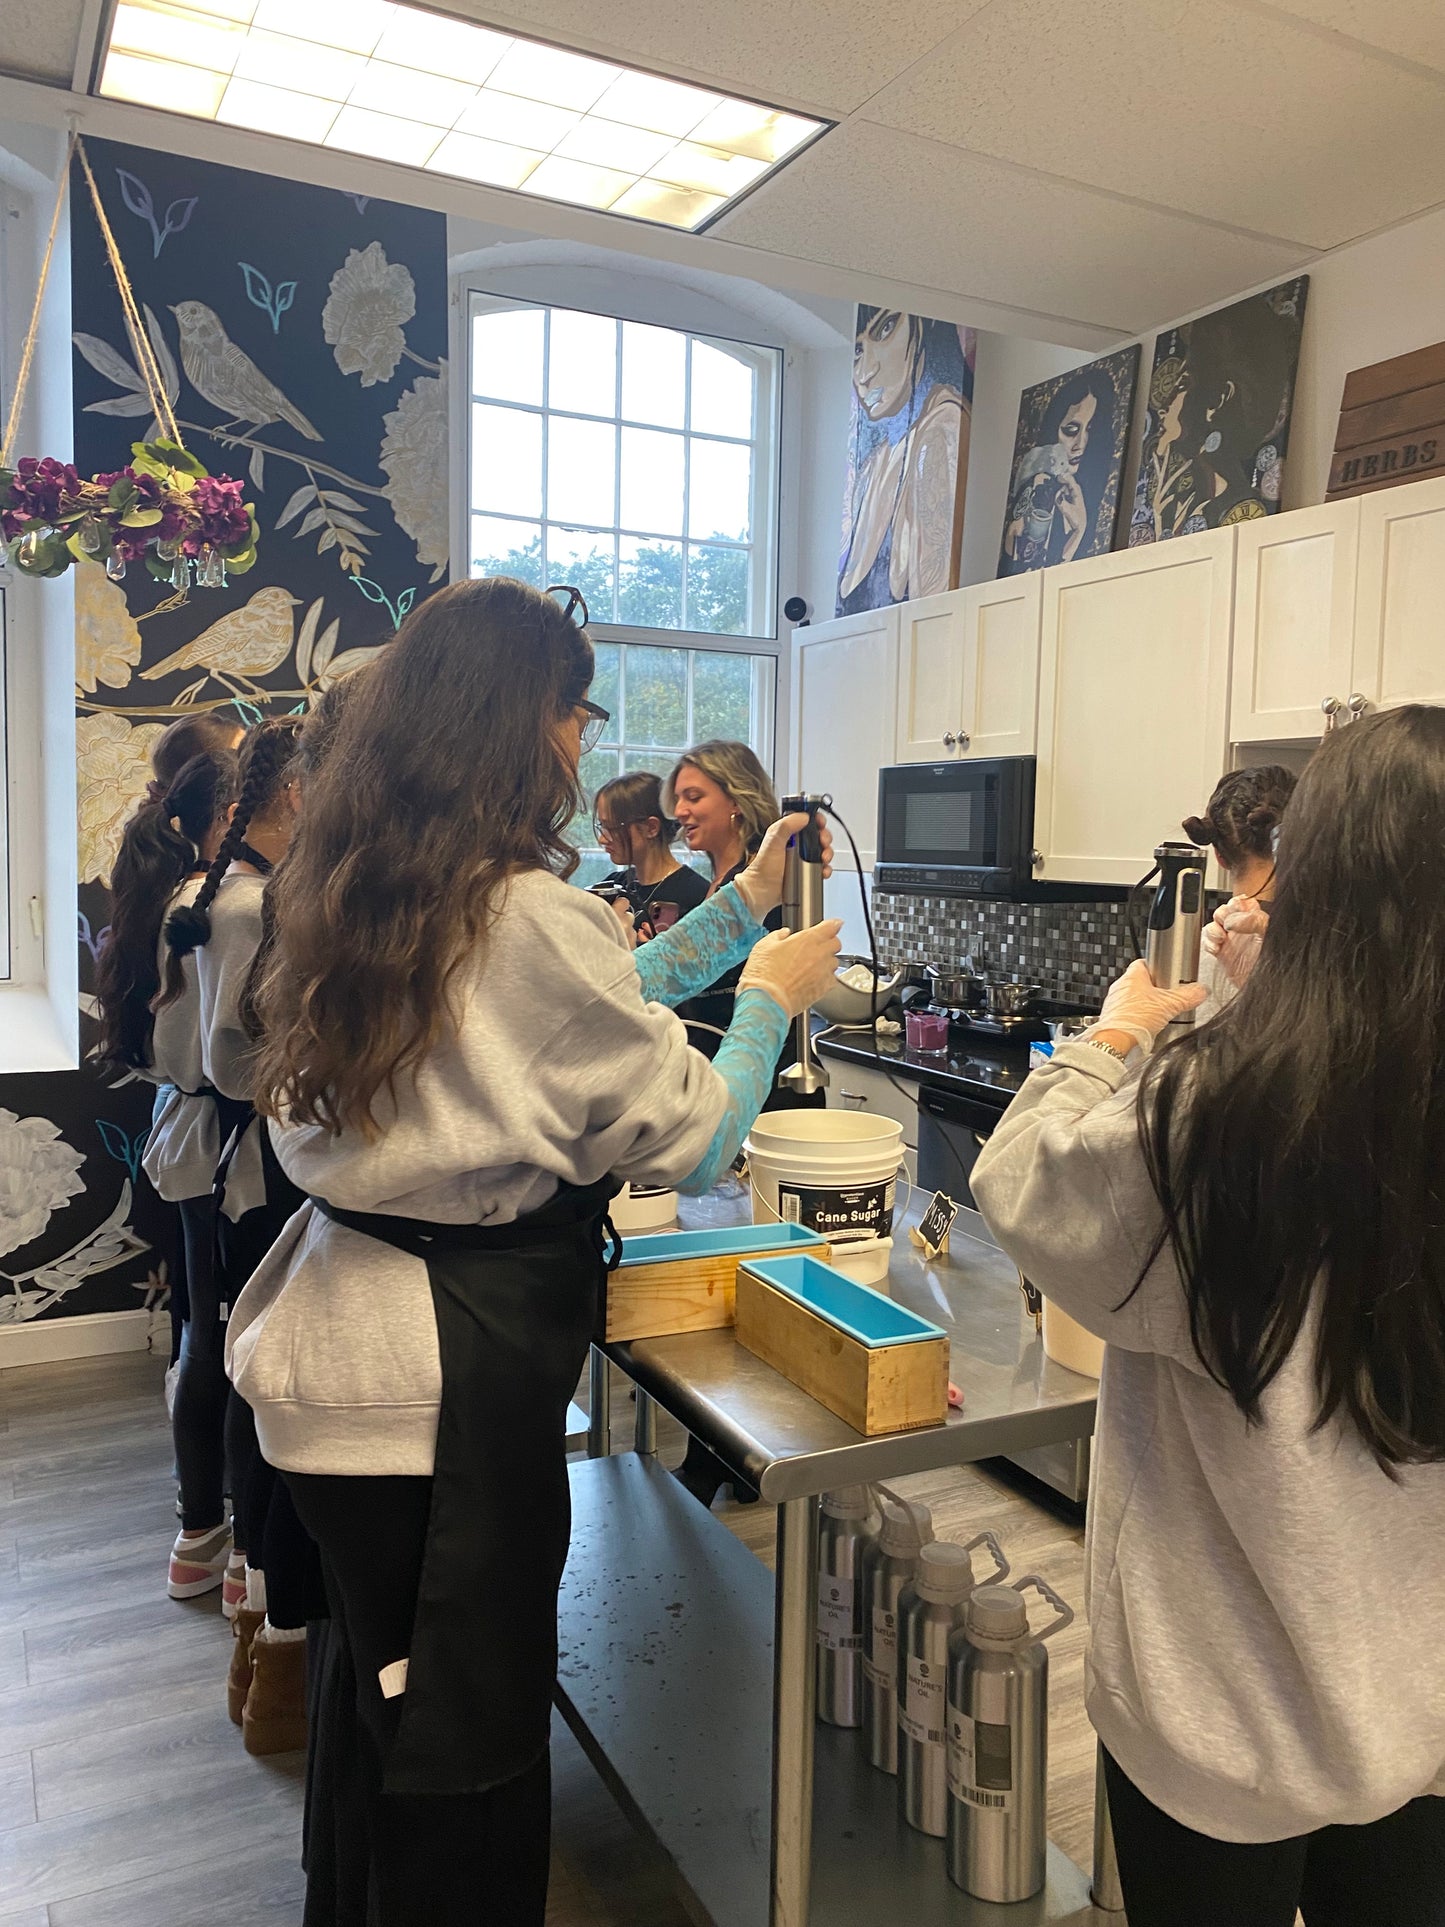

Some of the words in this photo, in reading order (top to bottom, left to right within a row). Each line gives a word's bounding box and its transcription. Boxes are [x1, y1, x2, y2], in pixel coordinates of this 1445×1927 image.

[1341, 439, 1437, 482] HERBS
[816, 1211, 848, 1223] Cane
[850, 1208, 881, 1222] Sugar
[874, 1625, 896, 1639] NATUR
[908, 1674, 943, 1693] NATURE'S
